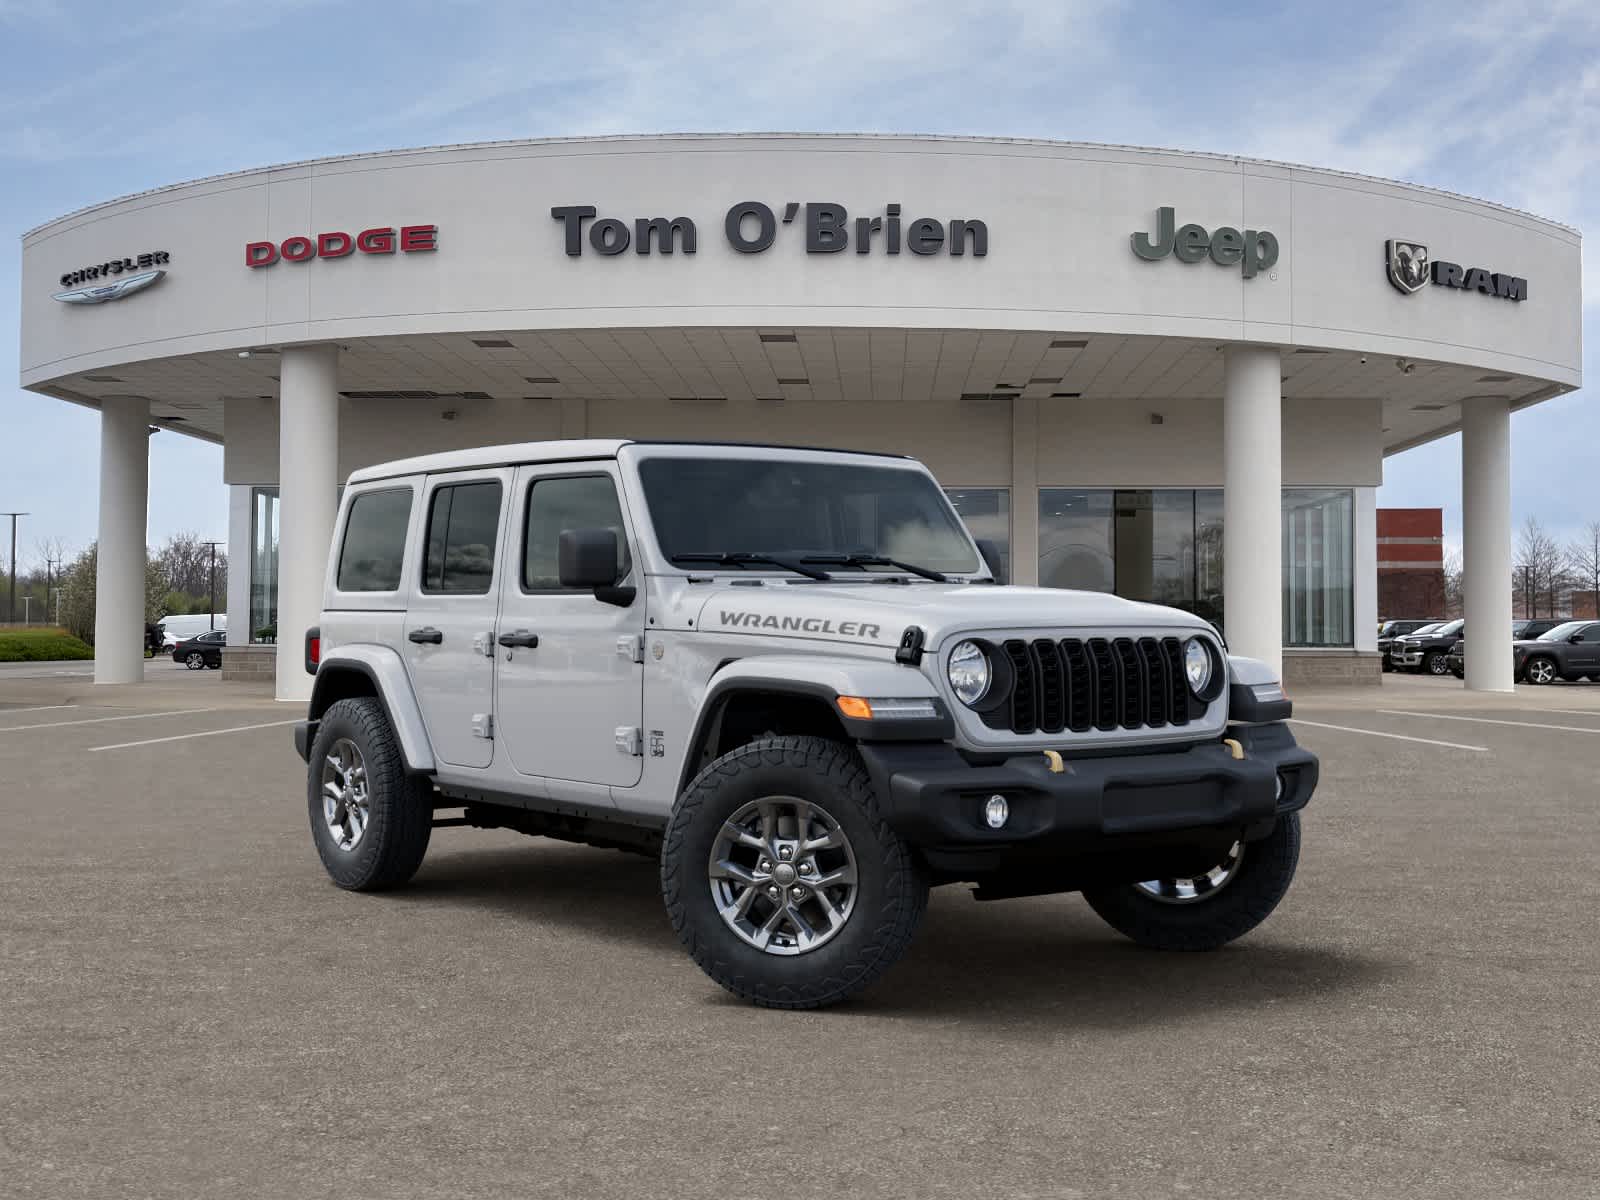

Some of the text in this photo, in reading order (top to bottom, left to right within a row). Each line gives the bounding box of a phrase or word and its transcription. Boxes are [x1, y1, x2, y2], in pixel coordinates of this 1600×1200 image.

[245, 224, 438, 268] DODGE
[551, 201, 988, 257] Tom O'Brien
[1130, 206, 1279, 279] Jeep
[60, 250, 170, 287] CHRYSLER
[1431, 260, 1528, 301] RAM
[719, 611, 881, 638] WRANGLER
